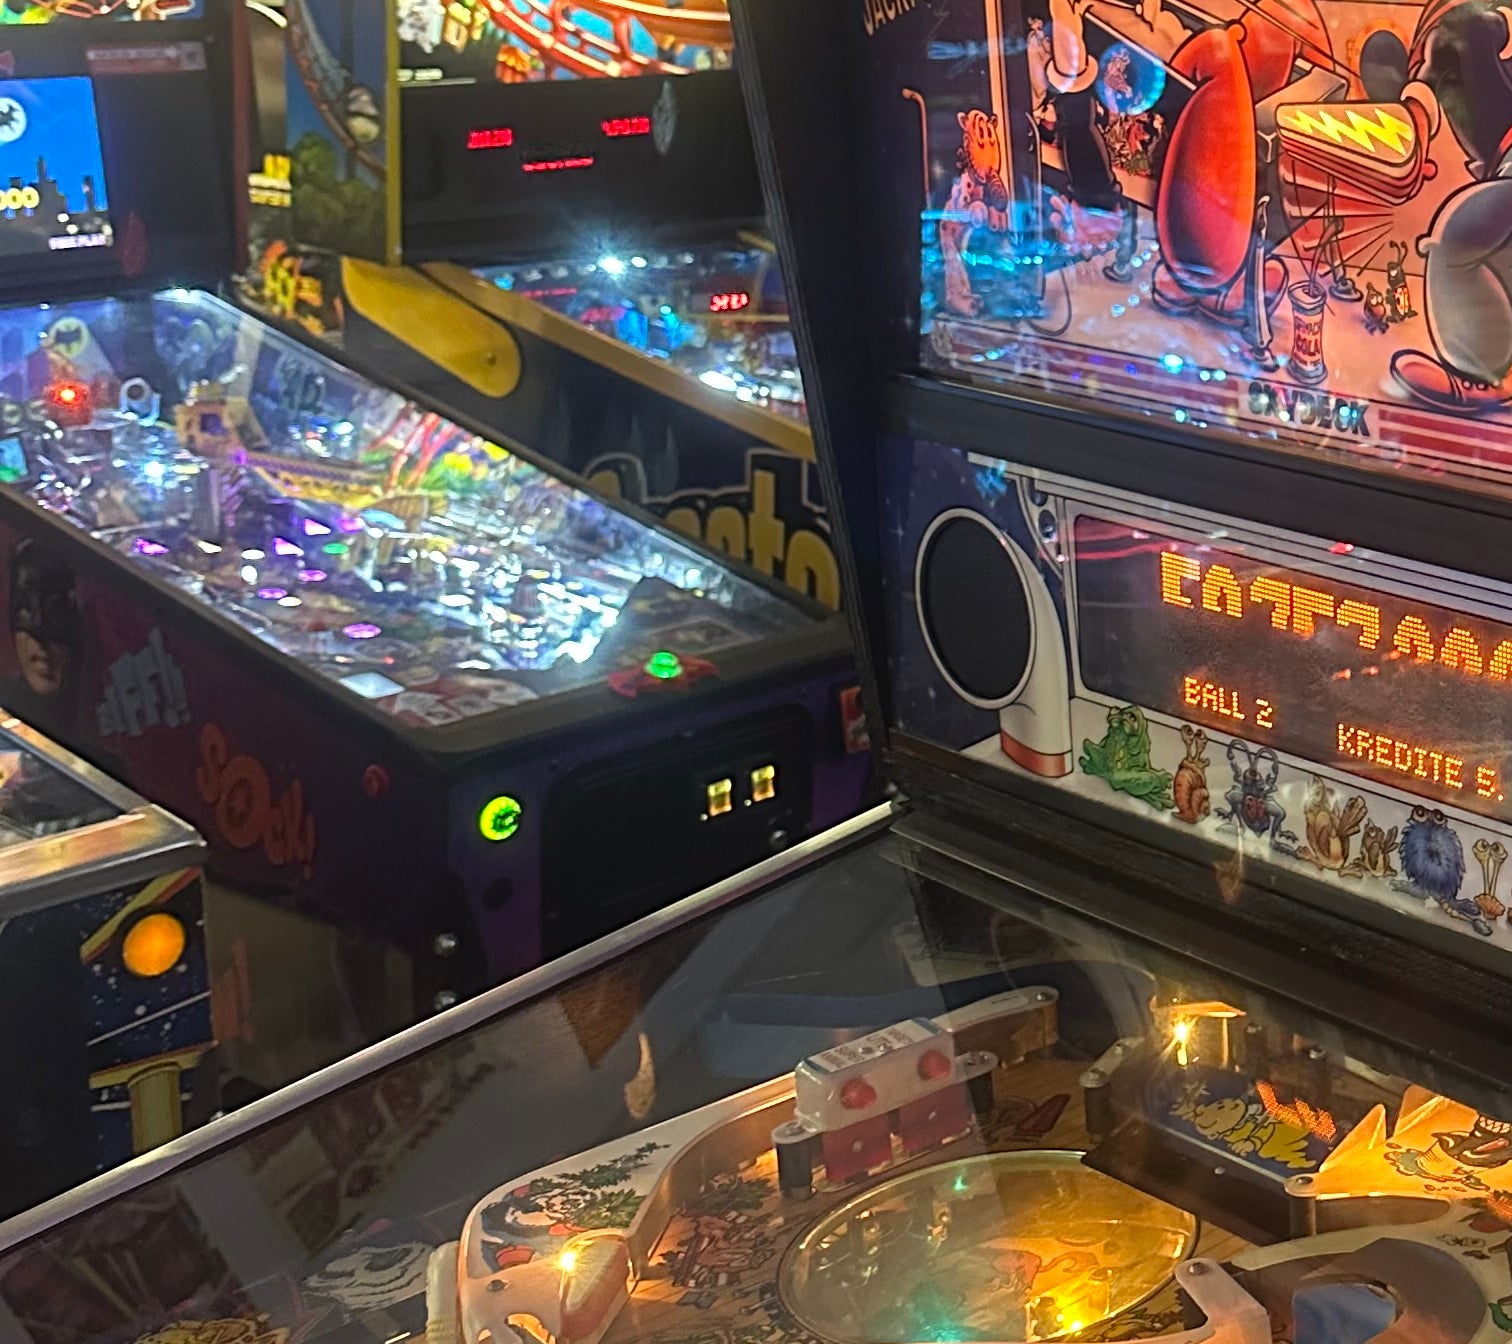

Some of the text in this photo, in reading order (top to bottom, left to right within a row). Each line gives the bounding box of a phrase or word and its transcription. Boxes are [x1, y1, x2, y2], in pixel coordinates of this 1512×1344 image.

[1248, 381, 1370, 436] SKYDECK
[1183, 676, 1273, 728] BALL 2
[1337, 723, 1464, 789] KREDITE
